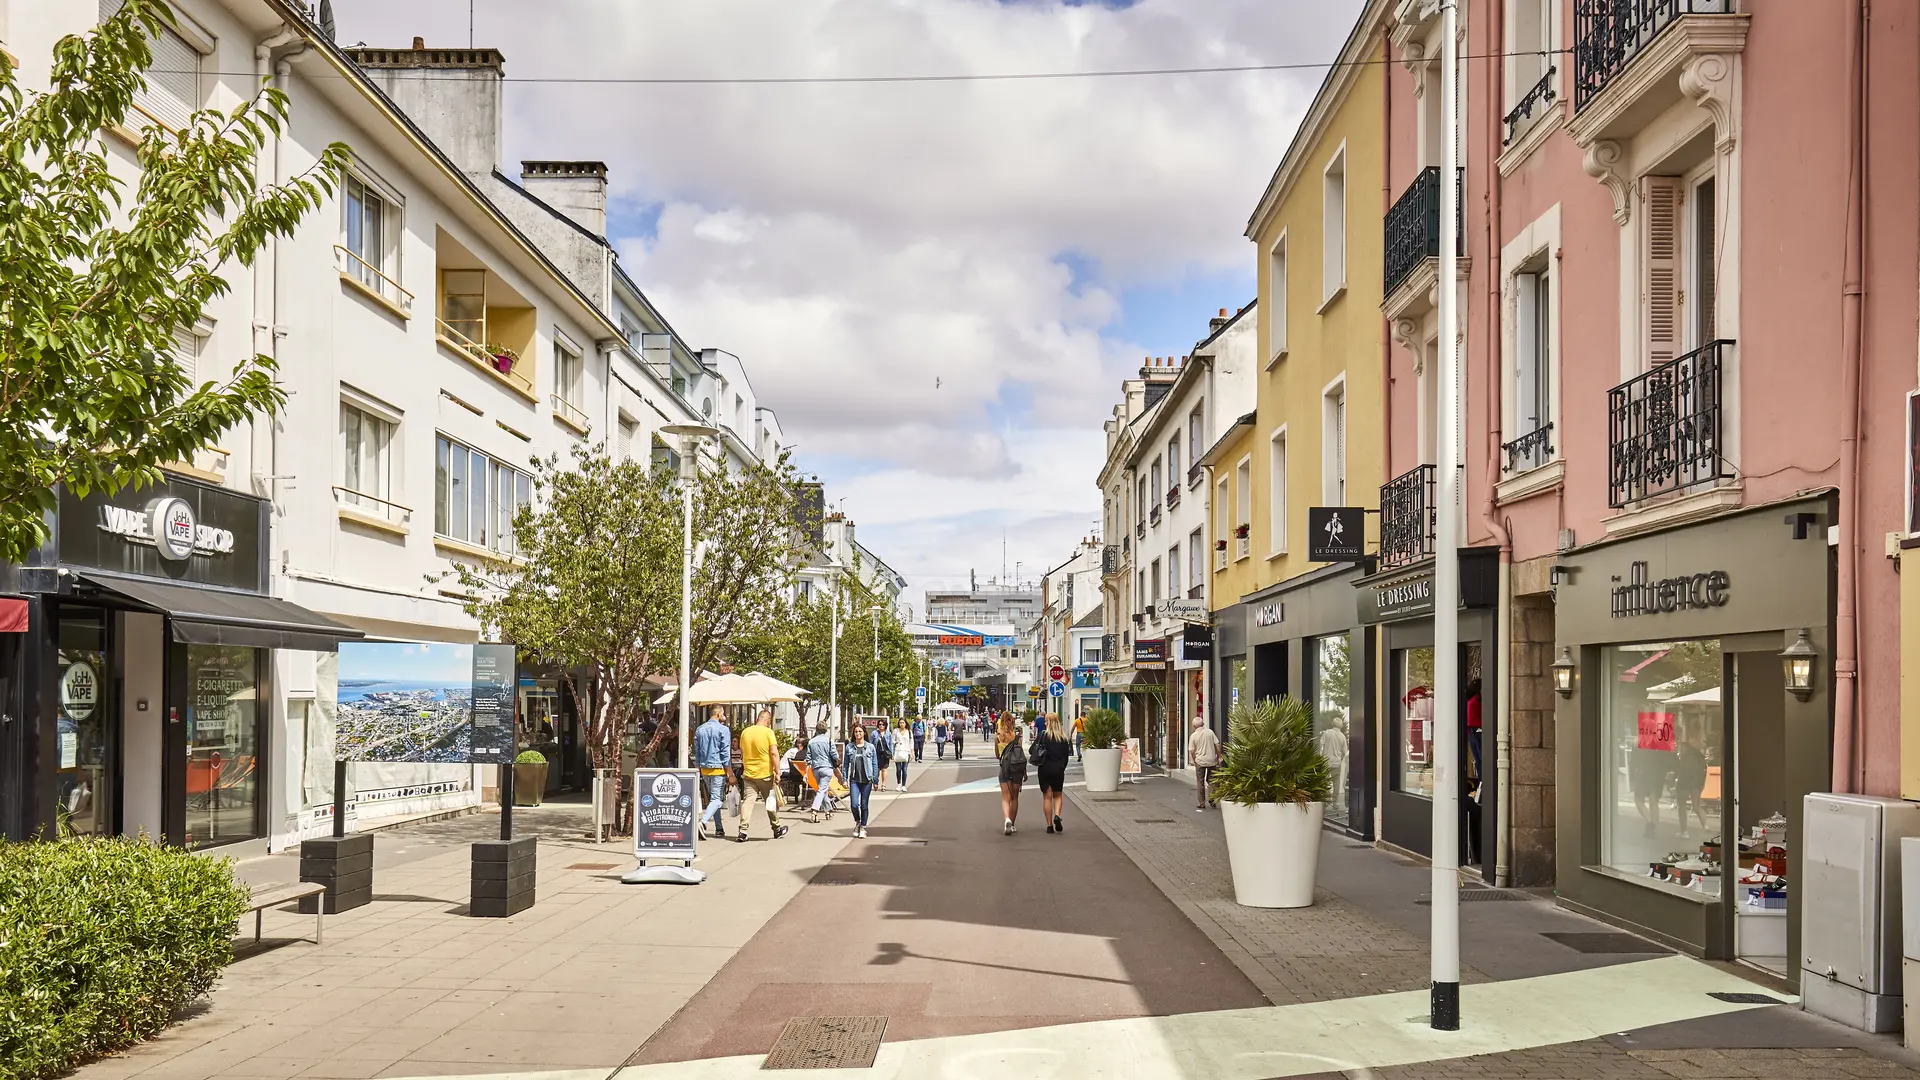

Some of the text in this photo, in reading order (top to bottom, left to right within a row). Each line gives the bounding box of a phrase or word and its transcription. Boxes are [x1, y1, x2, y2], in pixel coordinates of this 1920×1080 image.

[104, 504, 148, 537] VAPE
[170, 520, 190, 538] VAPE
[195, 524, 234, 552] SHOP
[1377, 581, 1429, 607] LE DRESSING
[1611, 560, 1730, 619] influence
[1157, 600, 1201, 615] Margaux
[1256, 602, 1282, 627] MORGAN
[940, 635, 1015, 646] RUBAN BLEU
[67, 684, 92, 700] VAPE
[656, 785, 676, 794] VAPE
